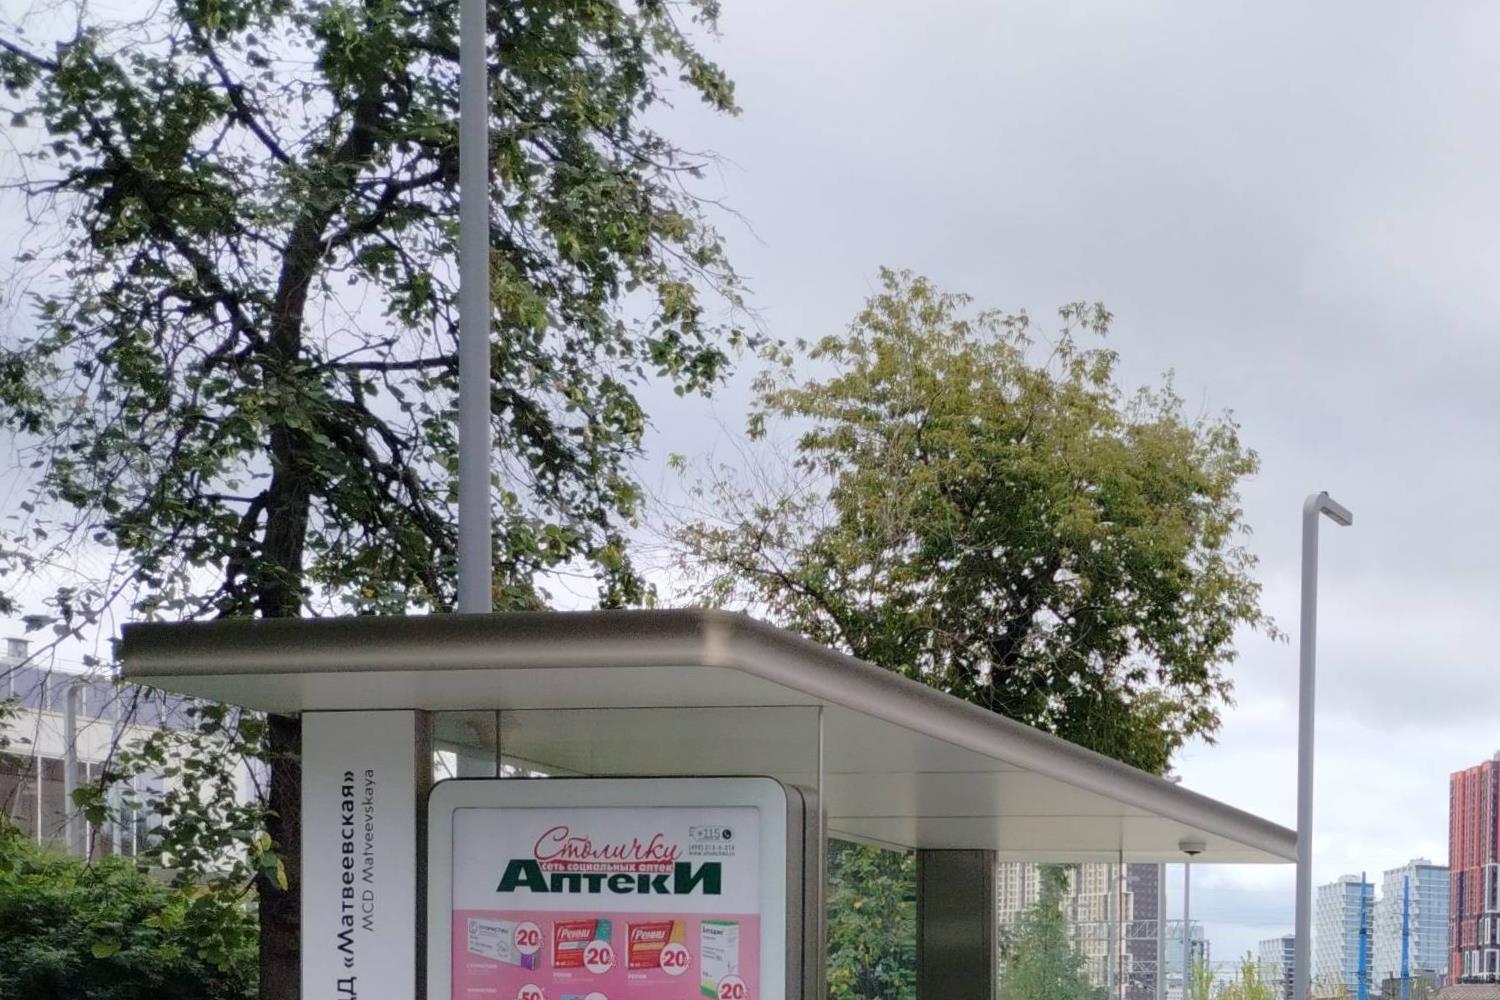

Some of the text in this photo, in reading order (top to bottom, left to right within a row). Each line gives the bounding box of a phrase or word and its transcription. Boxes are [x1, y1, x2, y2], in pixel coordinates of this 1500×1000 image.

[336, 770, 356, 969] «Матвеевская»
[361, 769, 376, 932] MCD Matveevskaya
[533, 826, 682, 860] Столички
[542, 863, 564, 872] сеть
[567, 863, 635, 873] социальных
